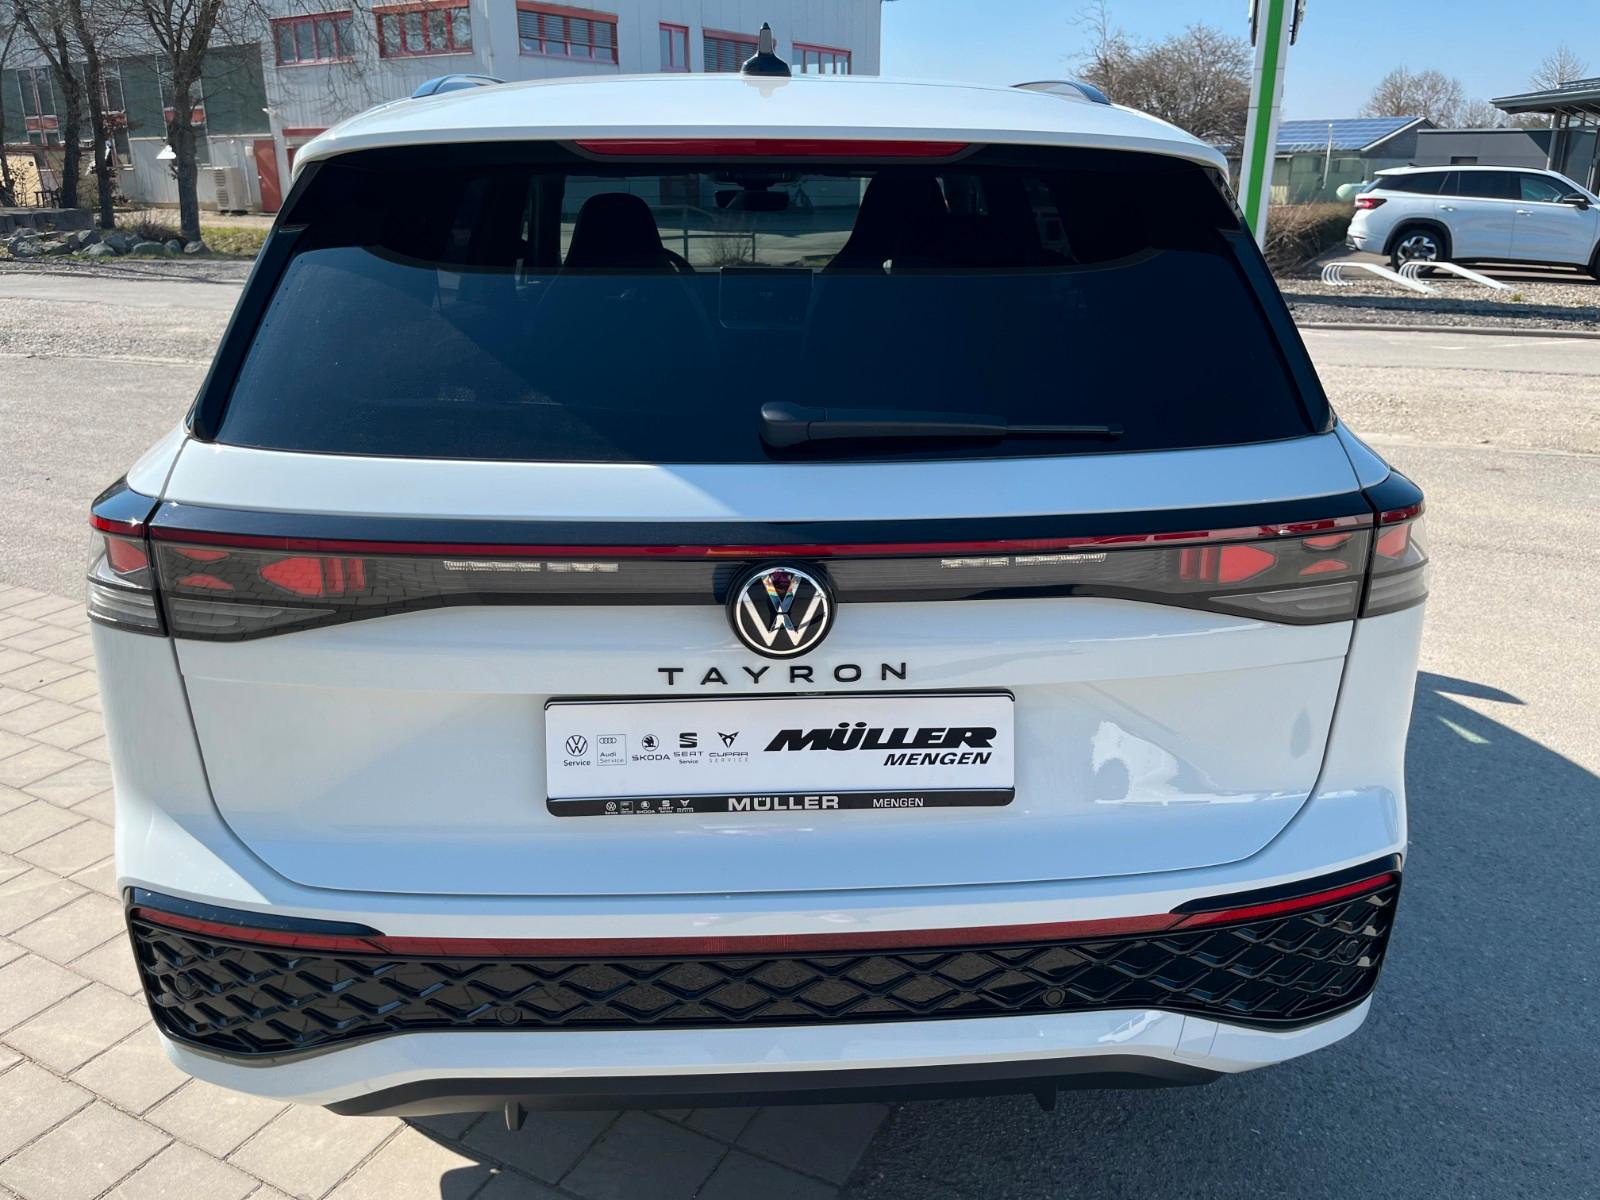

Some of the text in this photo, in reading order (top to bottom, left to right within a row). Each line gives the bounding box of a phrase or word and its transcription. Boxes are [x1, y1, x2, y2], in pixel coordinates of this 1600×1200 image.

[657, 662, 907, 686] TAYRON
[763, 721, 997, 752] MÜLLER
[563, 759, 591, 767] Service
[883, 752, 993, 766] MENGEN
[728, 795, 924, 812] MÜLLER MENGEN
